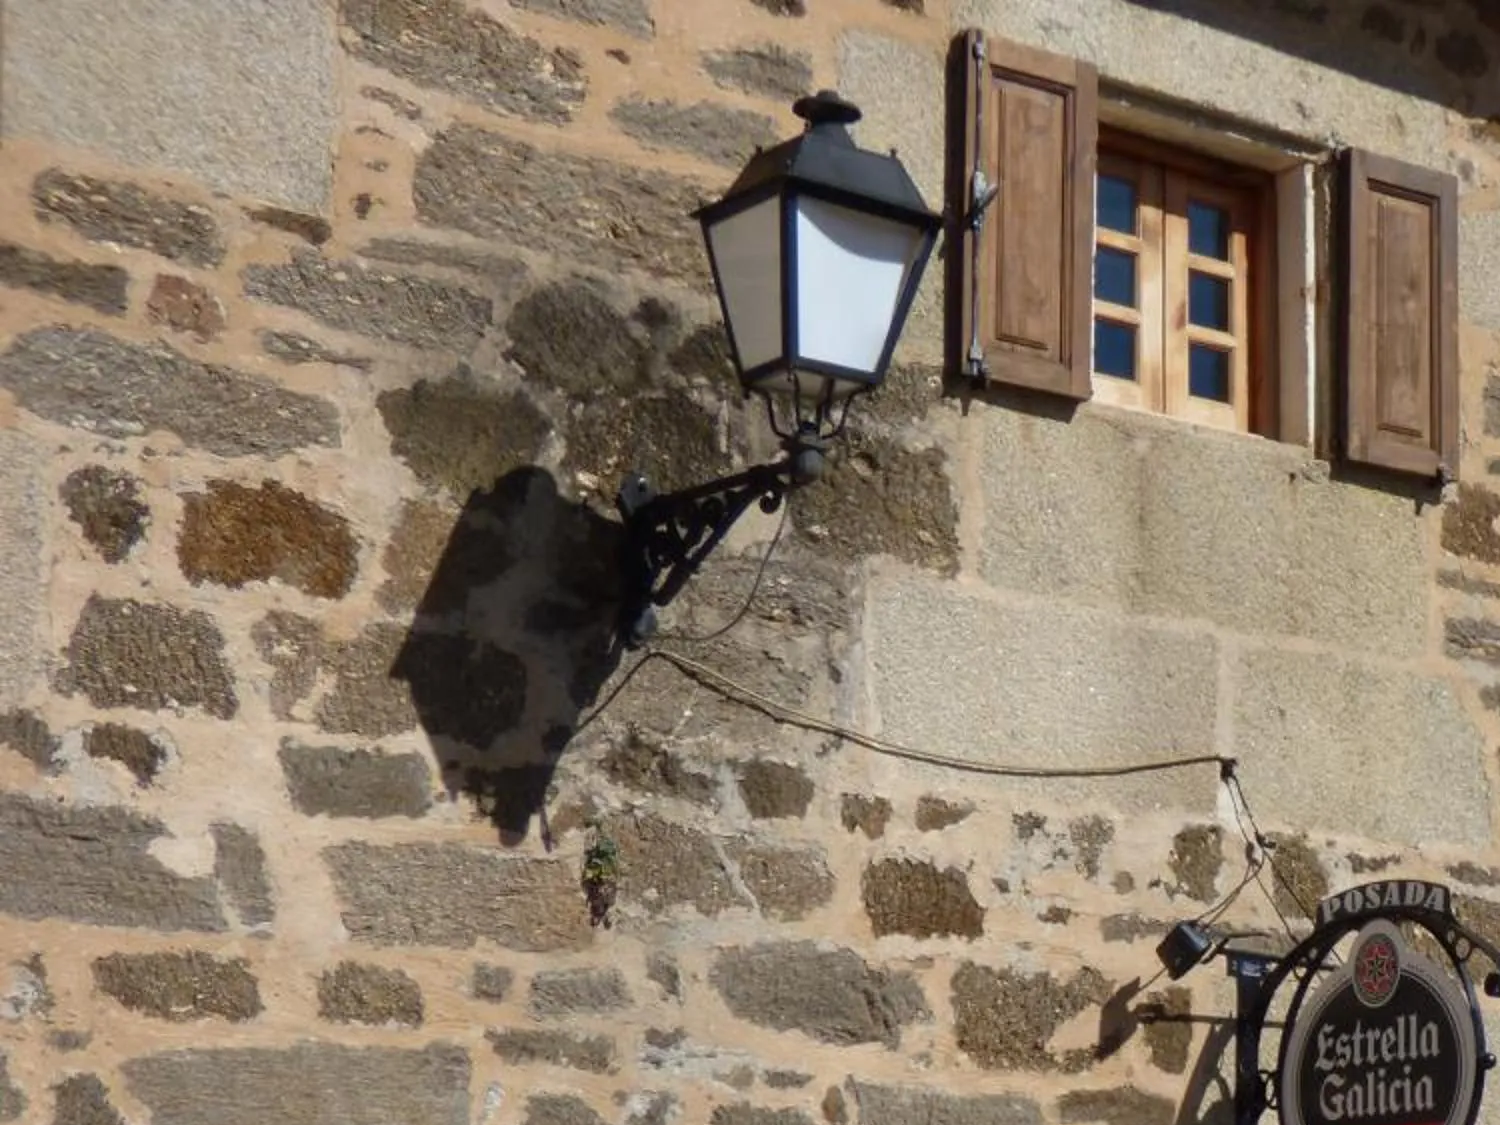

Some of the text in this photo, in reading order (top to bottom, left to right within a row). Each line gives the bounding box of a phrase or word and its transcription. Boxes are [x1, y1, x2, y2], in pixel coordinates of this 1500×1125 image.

[1322, 882, 1446, 921] POSADA
[1315, 1014, 1440, 1071] Estrella
[1320, 1064, 1433, 1121] Galicia
